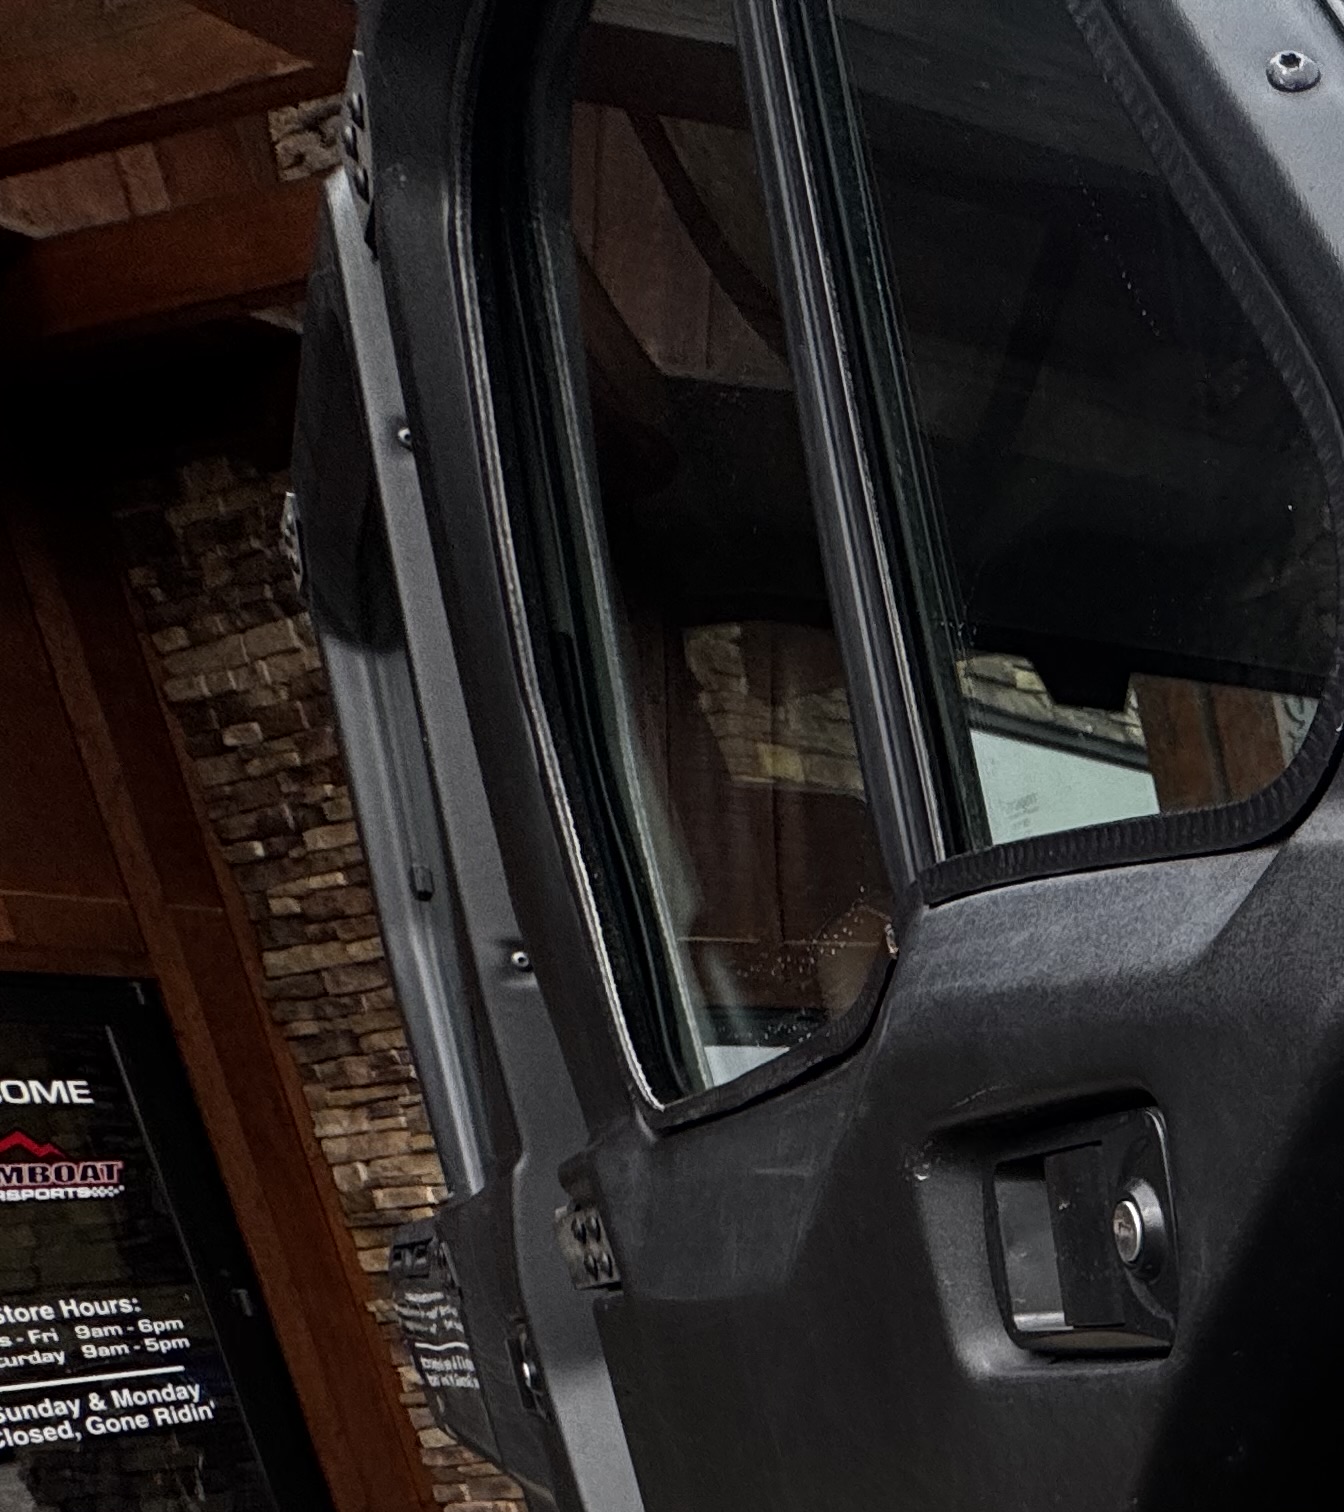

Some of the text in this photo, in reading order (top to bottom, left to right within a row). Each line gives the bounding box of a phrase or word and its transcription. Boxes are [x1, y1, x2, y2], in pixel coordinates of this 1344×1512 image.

[0, 1079, 95, 1104] OME
[58, 1298, 142, 1319] Hours:
[27, 1328, 60, 1344] Fri
[74, 1325, 123, 1339] 9am
[137, 1319, 185, 1335] 6pm
[81, 1344, 130, 1359] 9am
[144, 1337, 191, 1353] 5pm
[88, 1392, 107, 1411] &
[110, 1383, 200, 1409] Monday
[86, 1414, 149, 1435] Gone
[153, 1400, 216, 1426] Ridin'
